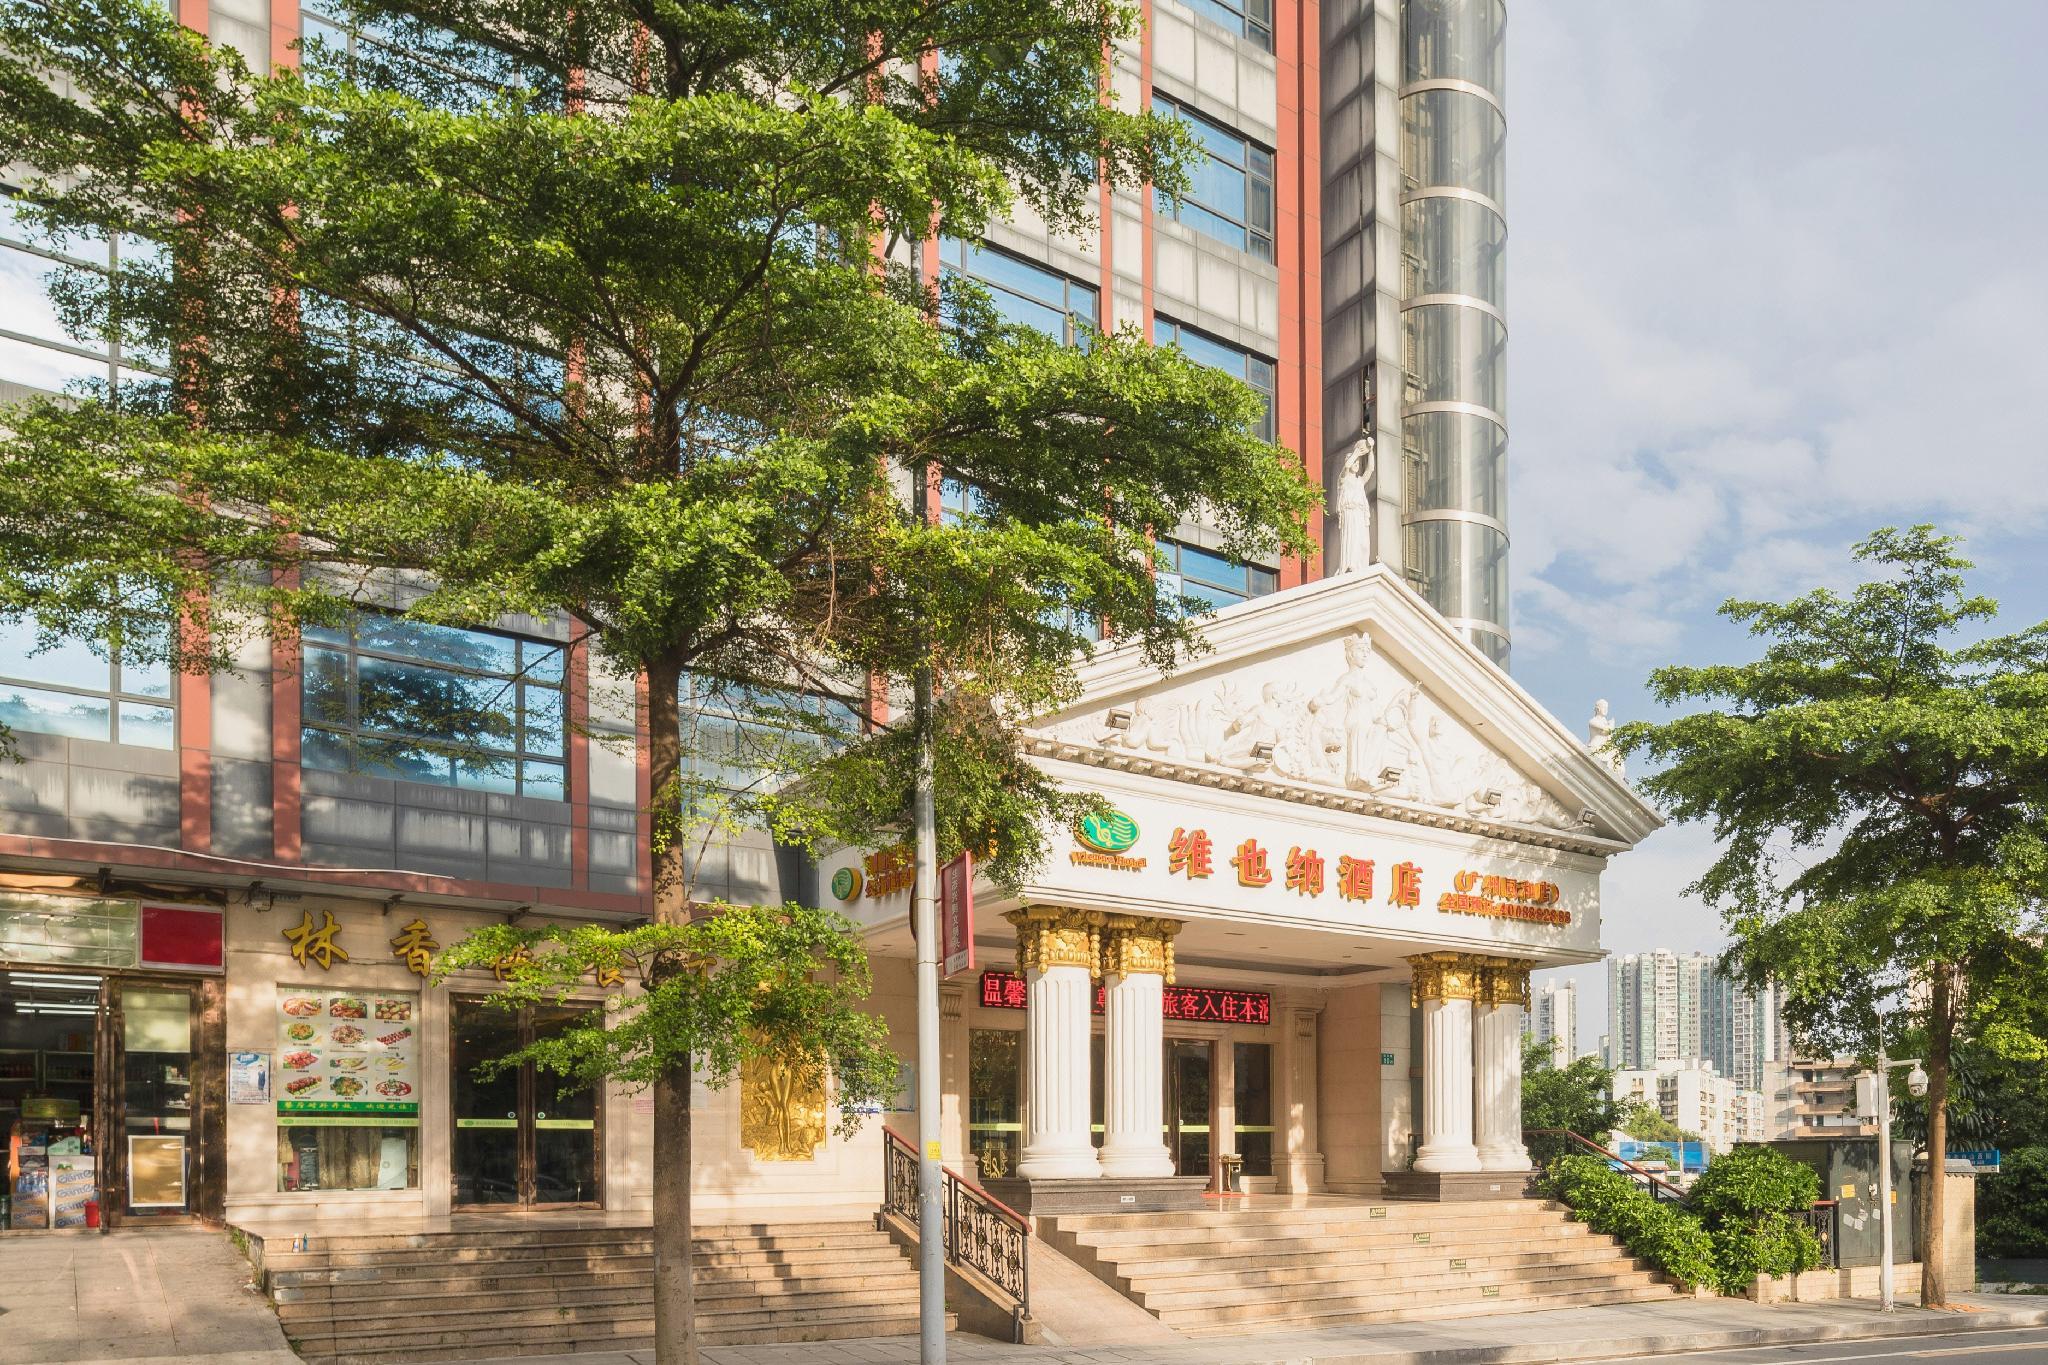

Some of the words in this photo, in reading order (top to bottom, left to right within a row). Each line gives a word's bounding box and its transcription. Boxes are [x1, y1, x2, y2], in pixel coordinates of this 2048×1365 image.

[1168, 827, 1425, 908] 维也纳酒店
